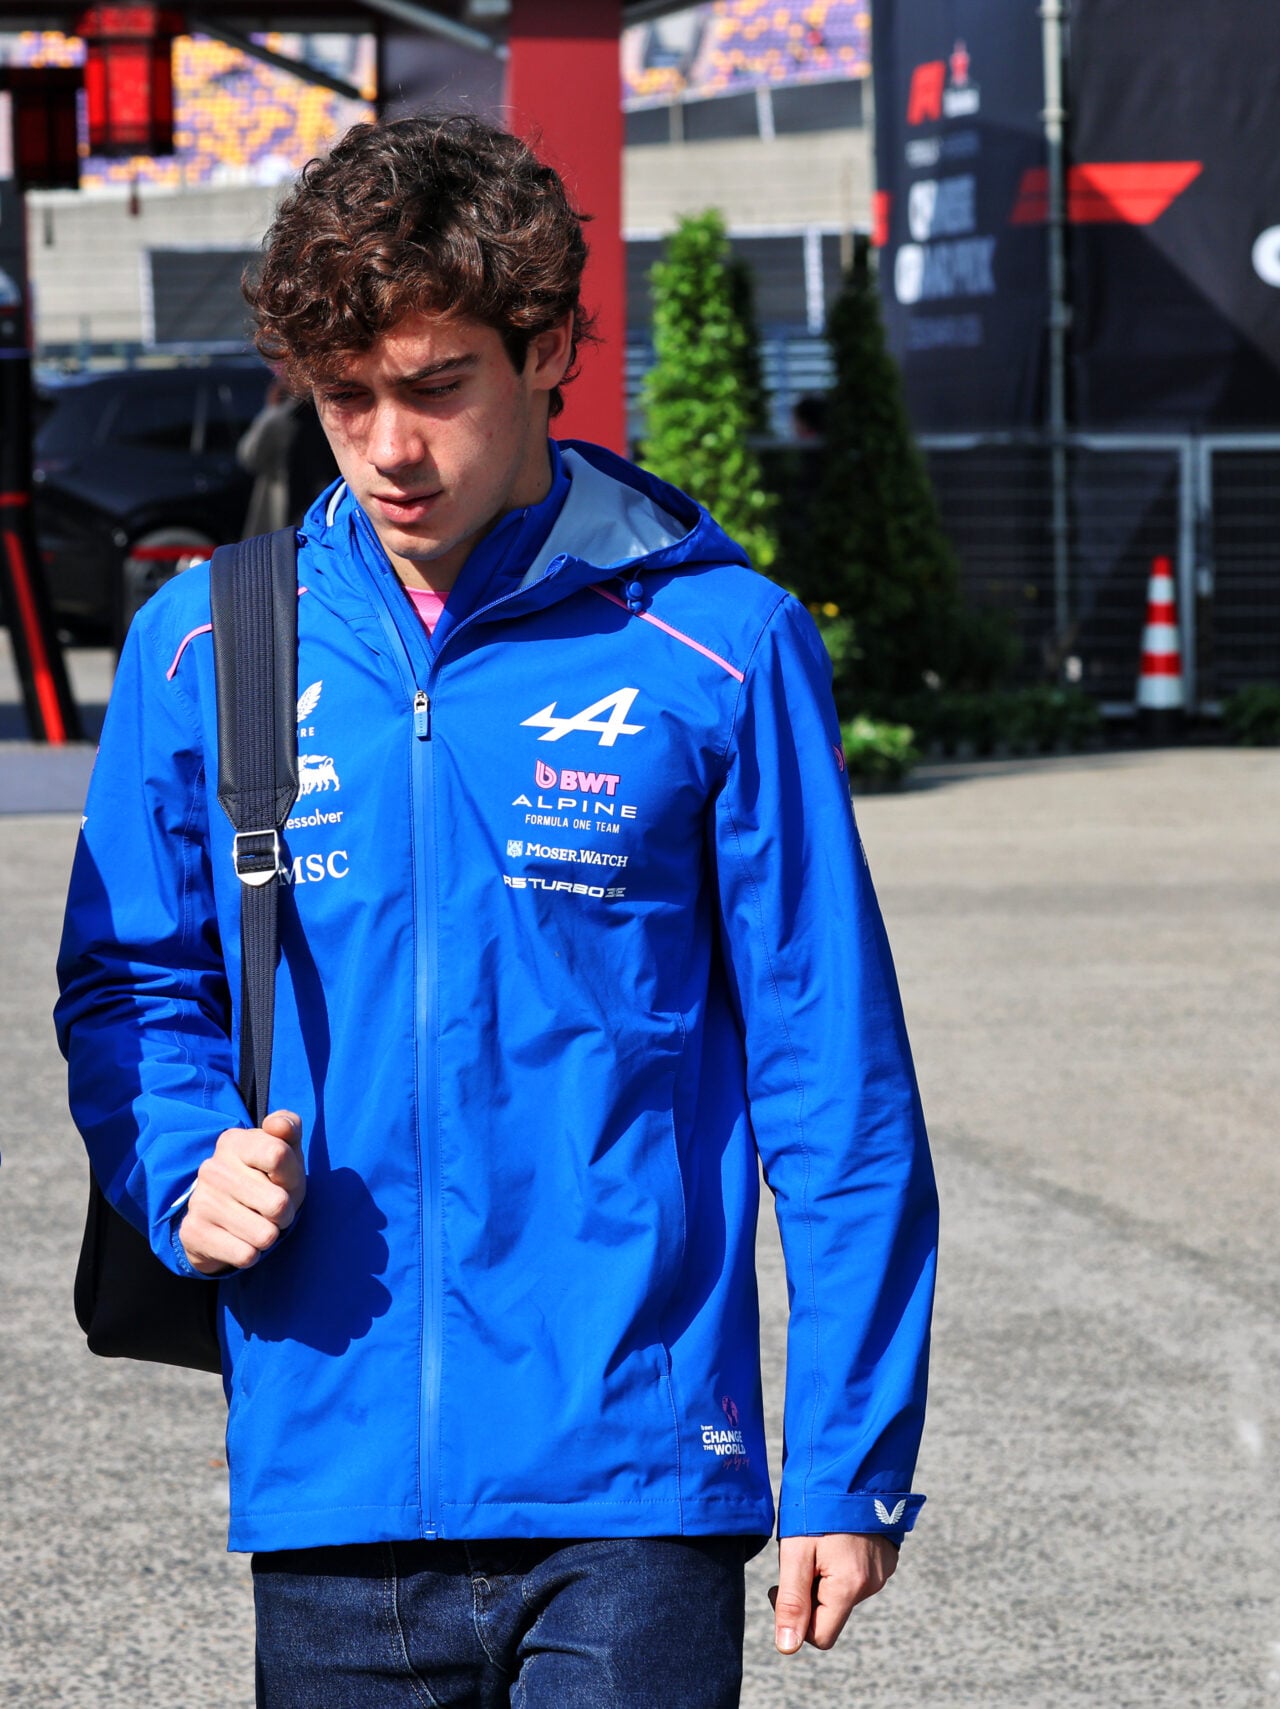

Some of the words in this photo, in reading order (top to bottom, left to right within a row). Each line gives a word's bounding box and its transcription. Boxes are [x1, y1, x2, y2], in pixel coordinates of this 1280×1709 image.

[559, 769, 621, 796] BWT
[511, 794, 638, 819] ALPINE
[283, 808, 344, 830] essolver
[525, 813, 569, 828] FORMULA
[573, 818, 592, 831] ONE
[596, 821, 620, 834] TEAM
[277, 850, 350, 886] MSC
[702, 1430, 743, 1444] CHANGE
[713, 1443, 746, 1456] WORLD
